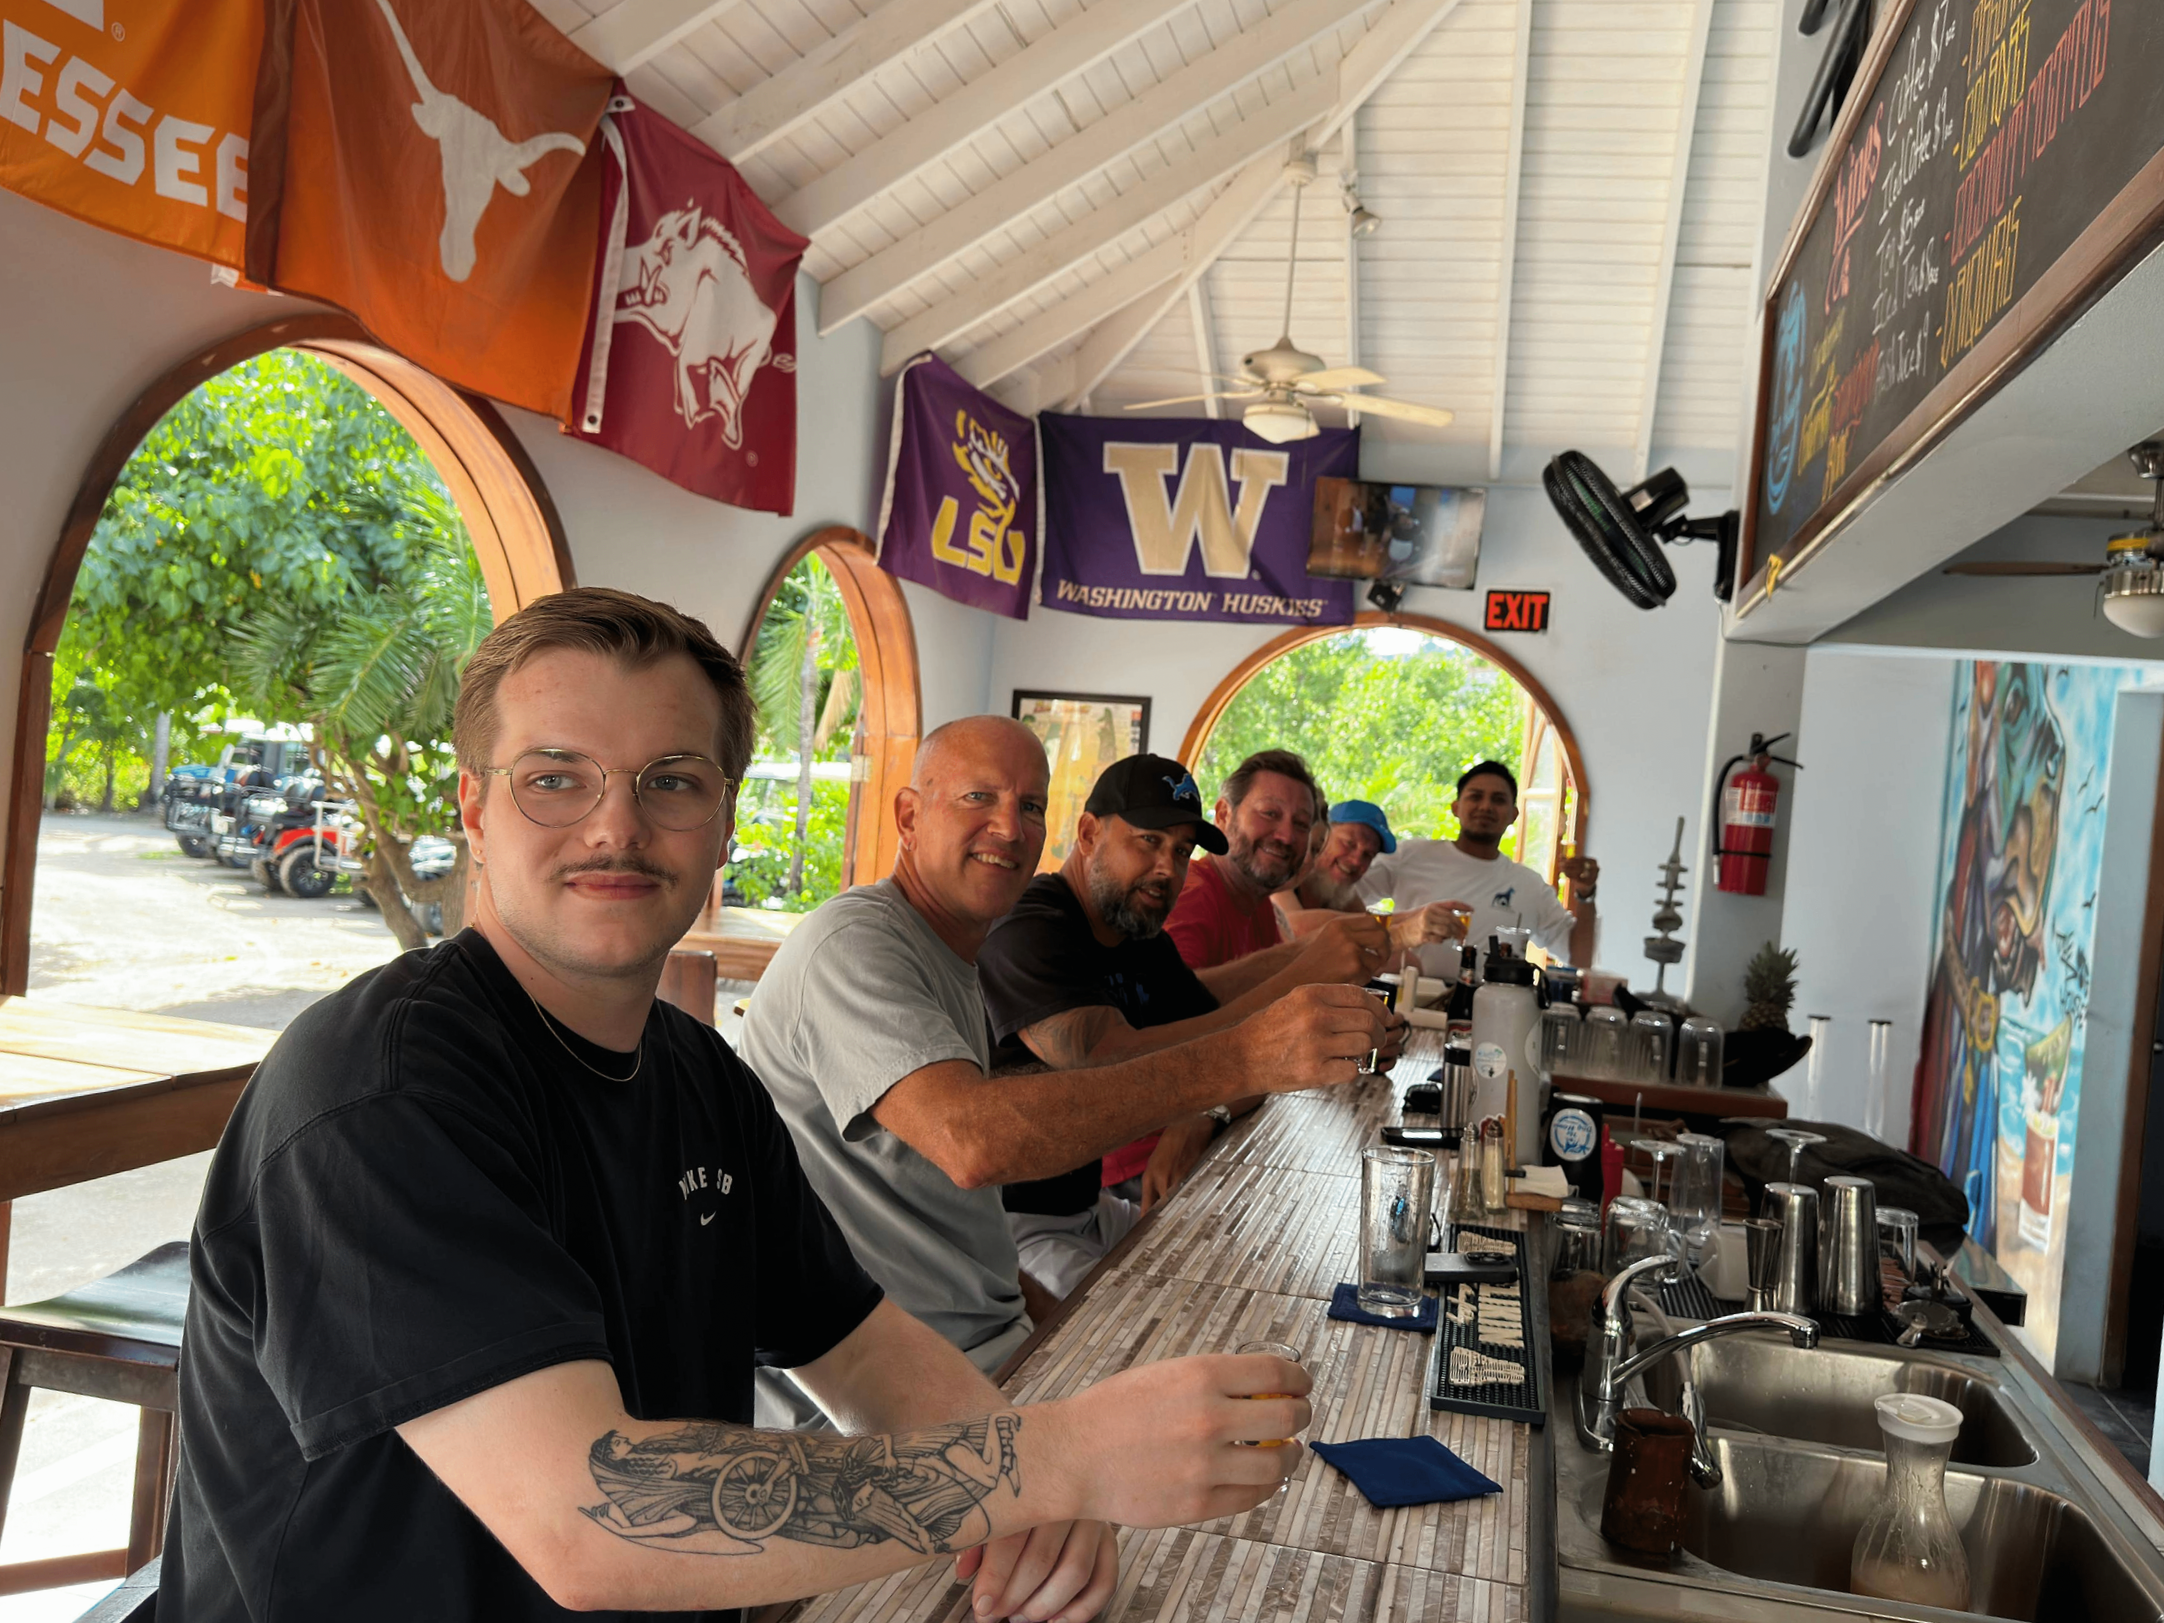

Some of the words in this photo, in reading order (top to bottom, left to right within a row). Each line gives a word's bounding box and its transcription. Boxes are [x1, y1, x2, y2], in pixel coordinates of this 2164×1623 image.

[1887, 24, 1925, 147] Coffee
[931, 495, 1026, 586] LSU
[1103, 441, 1290, 580] W
[1057, 579, 1213, 612] WASHINGTON
[1221, 593, 1324, 618] HUSKIES
[1486, 592, 1548, 630] EXIT
[678, 1166, 708, 1201] NKE
[716, 1168, 733, 1195] SB
